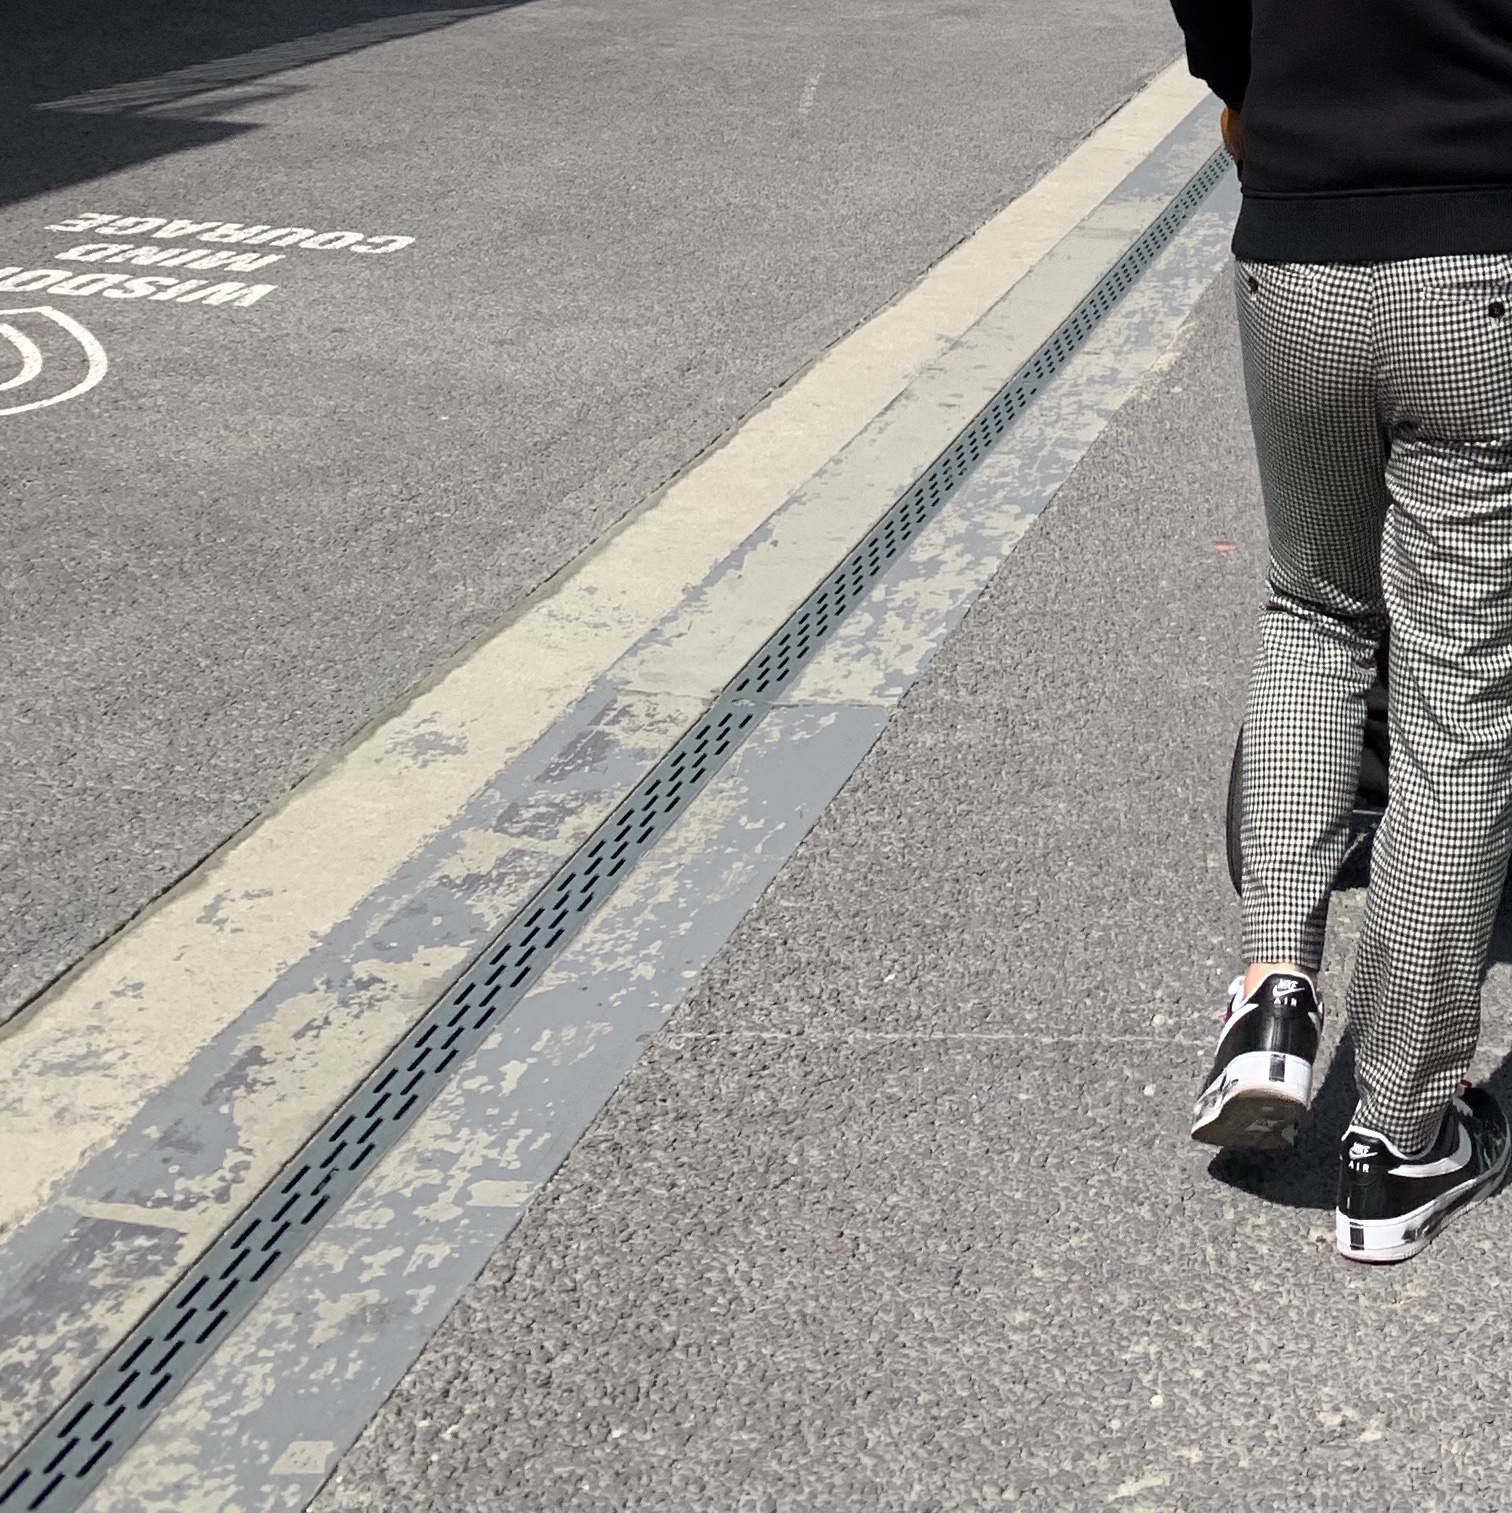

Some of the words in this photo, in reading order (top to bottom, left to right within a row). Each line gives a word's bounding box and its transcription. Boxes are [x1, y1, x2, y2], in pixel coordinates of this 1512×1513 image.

[44, 212, 416, 255] COURAGE
[54, 243, 287, 272] MIND
[1277, 978, 1299, 989] NIKE
[1273, 996, 1298, 1007] AIR
[1351, 1141, 1371, 1155] NIKE
[1348, 1160, 1370, 1173] AIR
